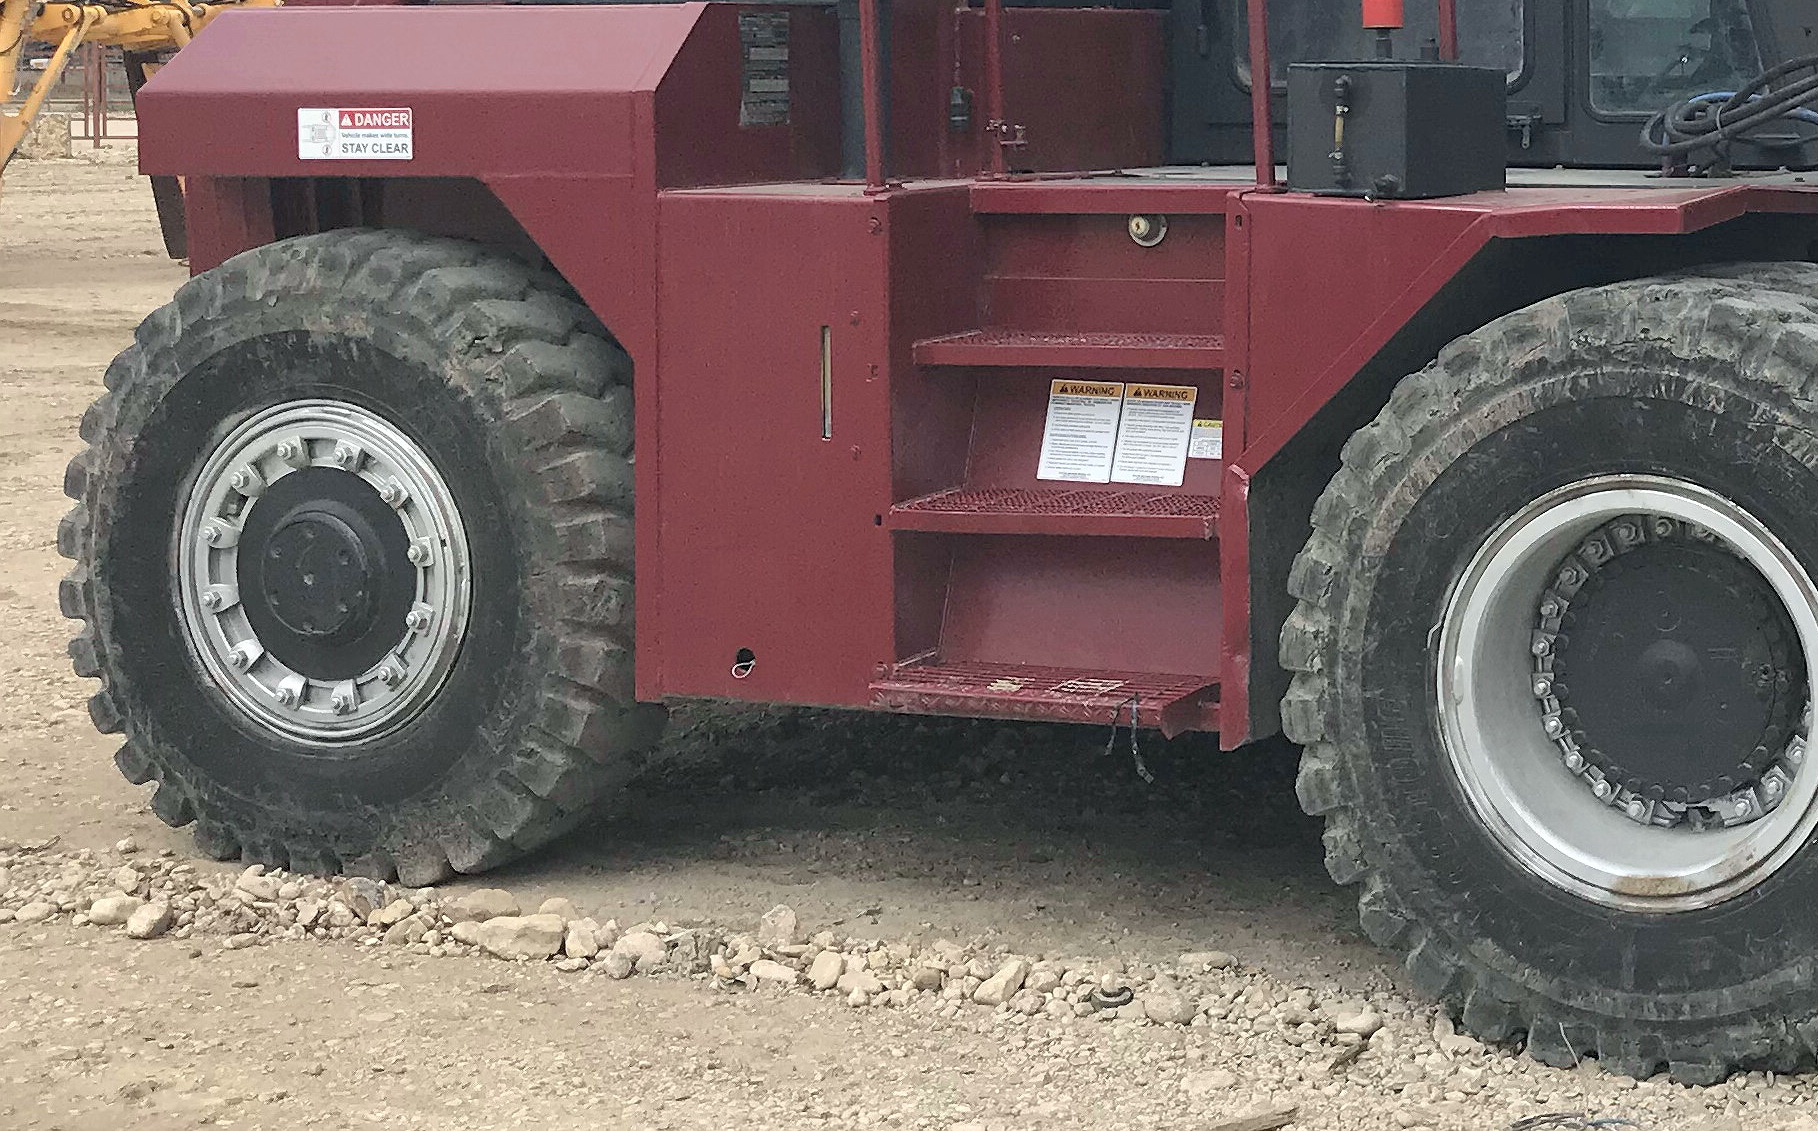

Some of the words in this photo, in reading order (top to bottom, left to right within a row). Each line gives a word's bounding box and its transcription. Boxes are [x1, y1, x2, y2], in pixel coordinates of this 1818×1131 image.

[354, 113, 409, 127] DANGER
[341, 142, 369, 154] STAY
[371, 142, 409, 154] CLEAR
[1070, 384, 1115, 396] WARNING
[1143, 388, 1188, 400] WARNING
